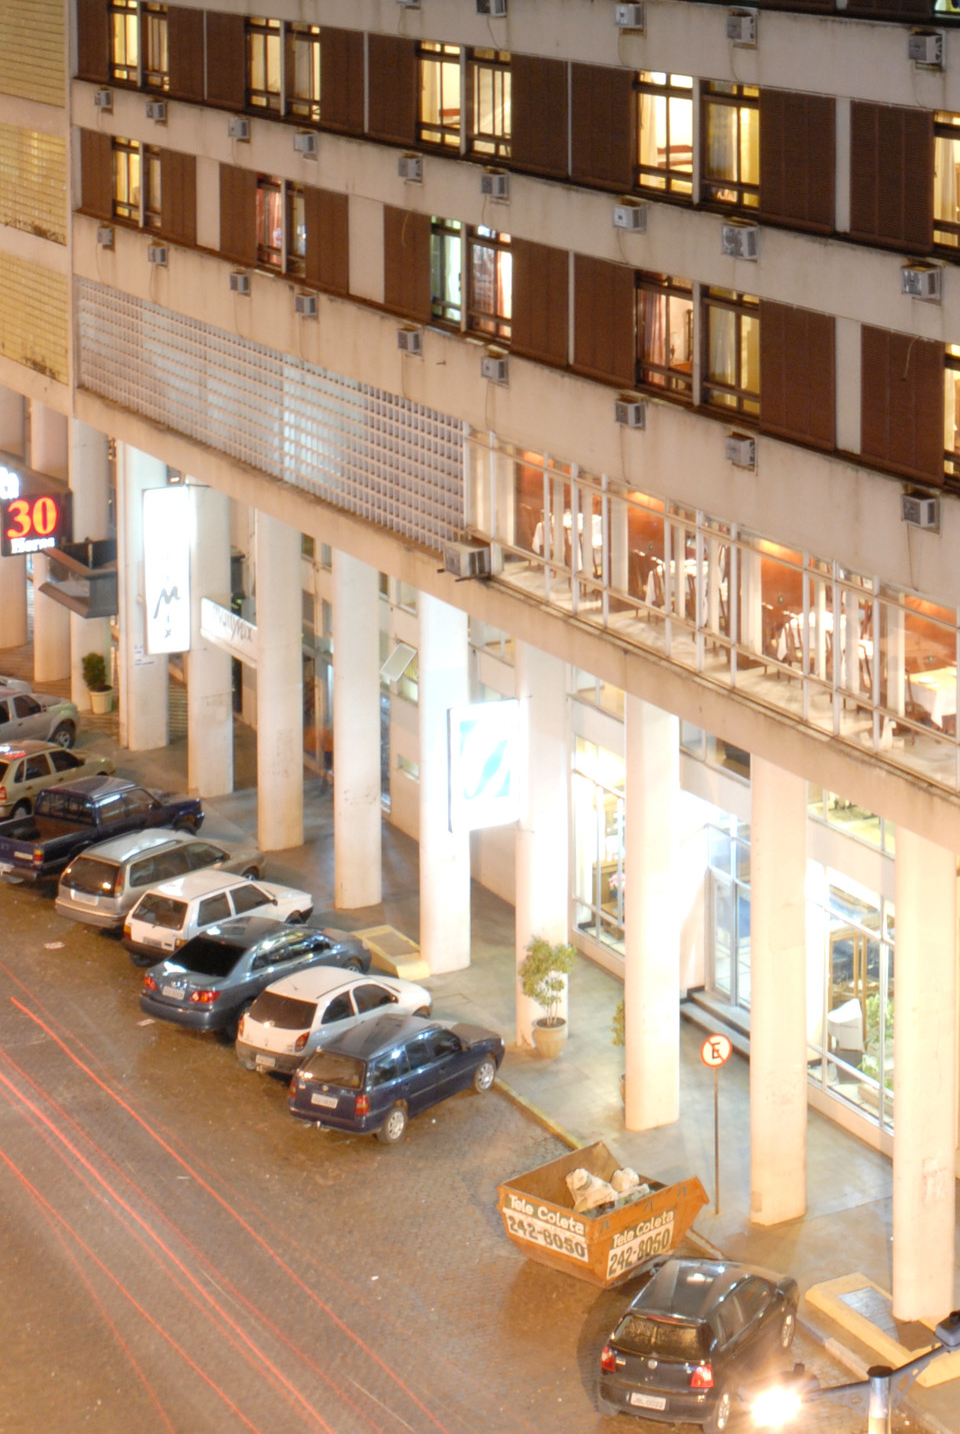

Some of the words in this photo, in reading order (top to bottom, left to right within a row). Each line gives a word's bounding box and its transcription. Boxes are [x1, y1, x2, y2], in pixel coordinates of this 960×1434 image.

[6, 496, 58, 539] 30
[712, 1041, 721, 1059] E
[509, 1195, 534, 1216] Tele
[537, 1206, 585, 1235] Coleta
[612, 1230, 635, 1248] Tele
[635, 1210, 675, 1237] Coleta
[508, 1215, 586, 1258] 242-8050
[608, 1227, 671, 1277] 242-8050
